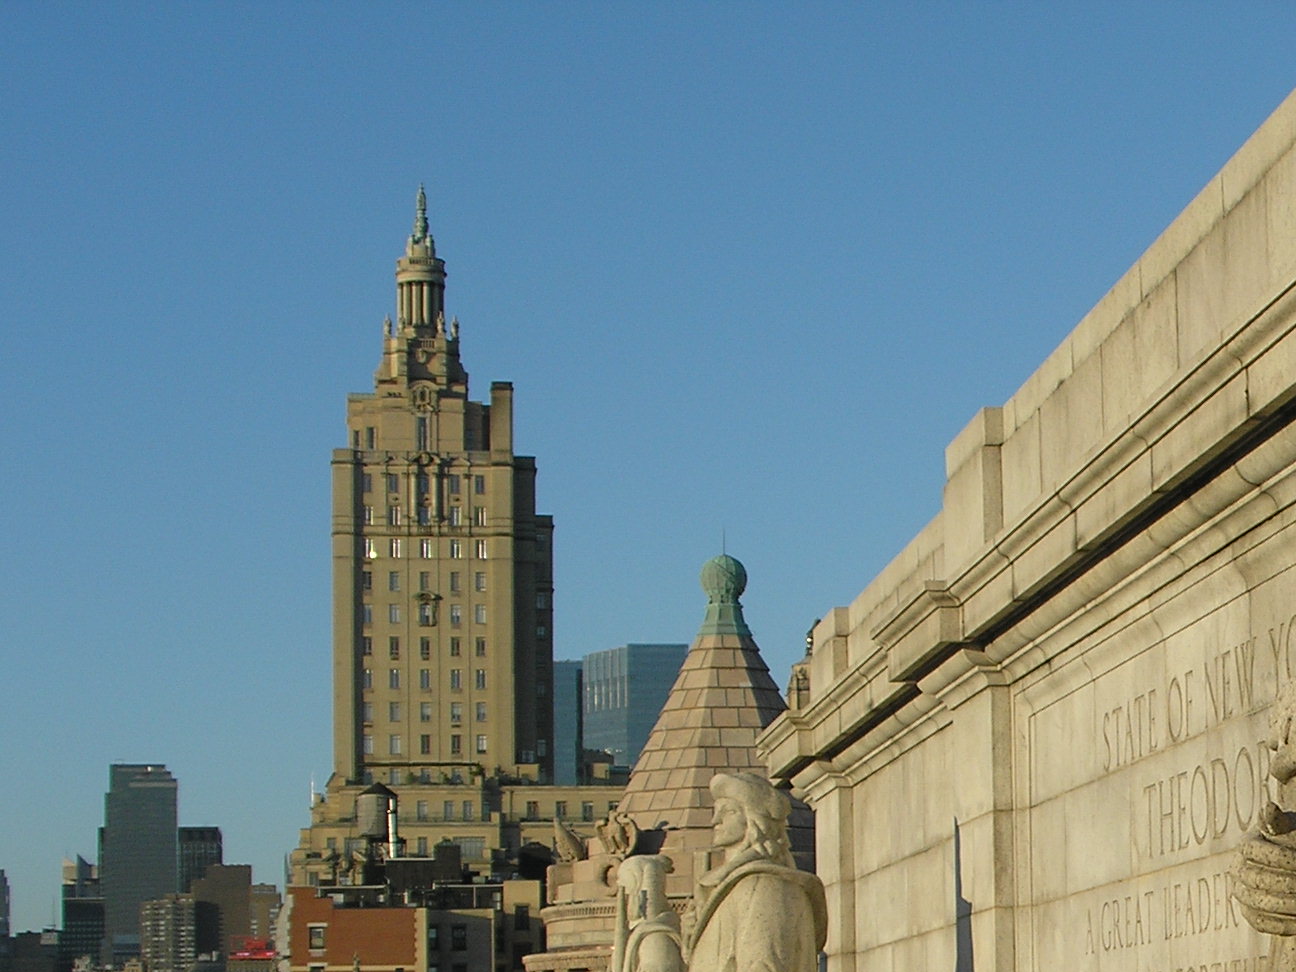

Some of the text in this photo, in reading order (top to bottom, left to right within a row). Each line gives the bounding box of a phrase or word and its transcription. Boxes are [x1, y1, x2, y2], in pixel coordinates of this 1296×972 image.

[1103, 688, 1158, 774] STATE
[1167, 669, 1194, 742] OF
[1204, 636, 1257, 729] NEW
[1086, 871, 1239, 955] A GREAT LEADER
